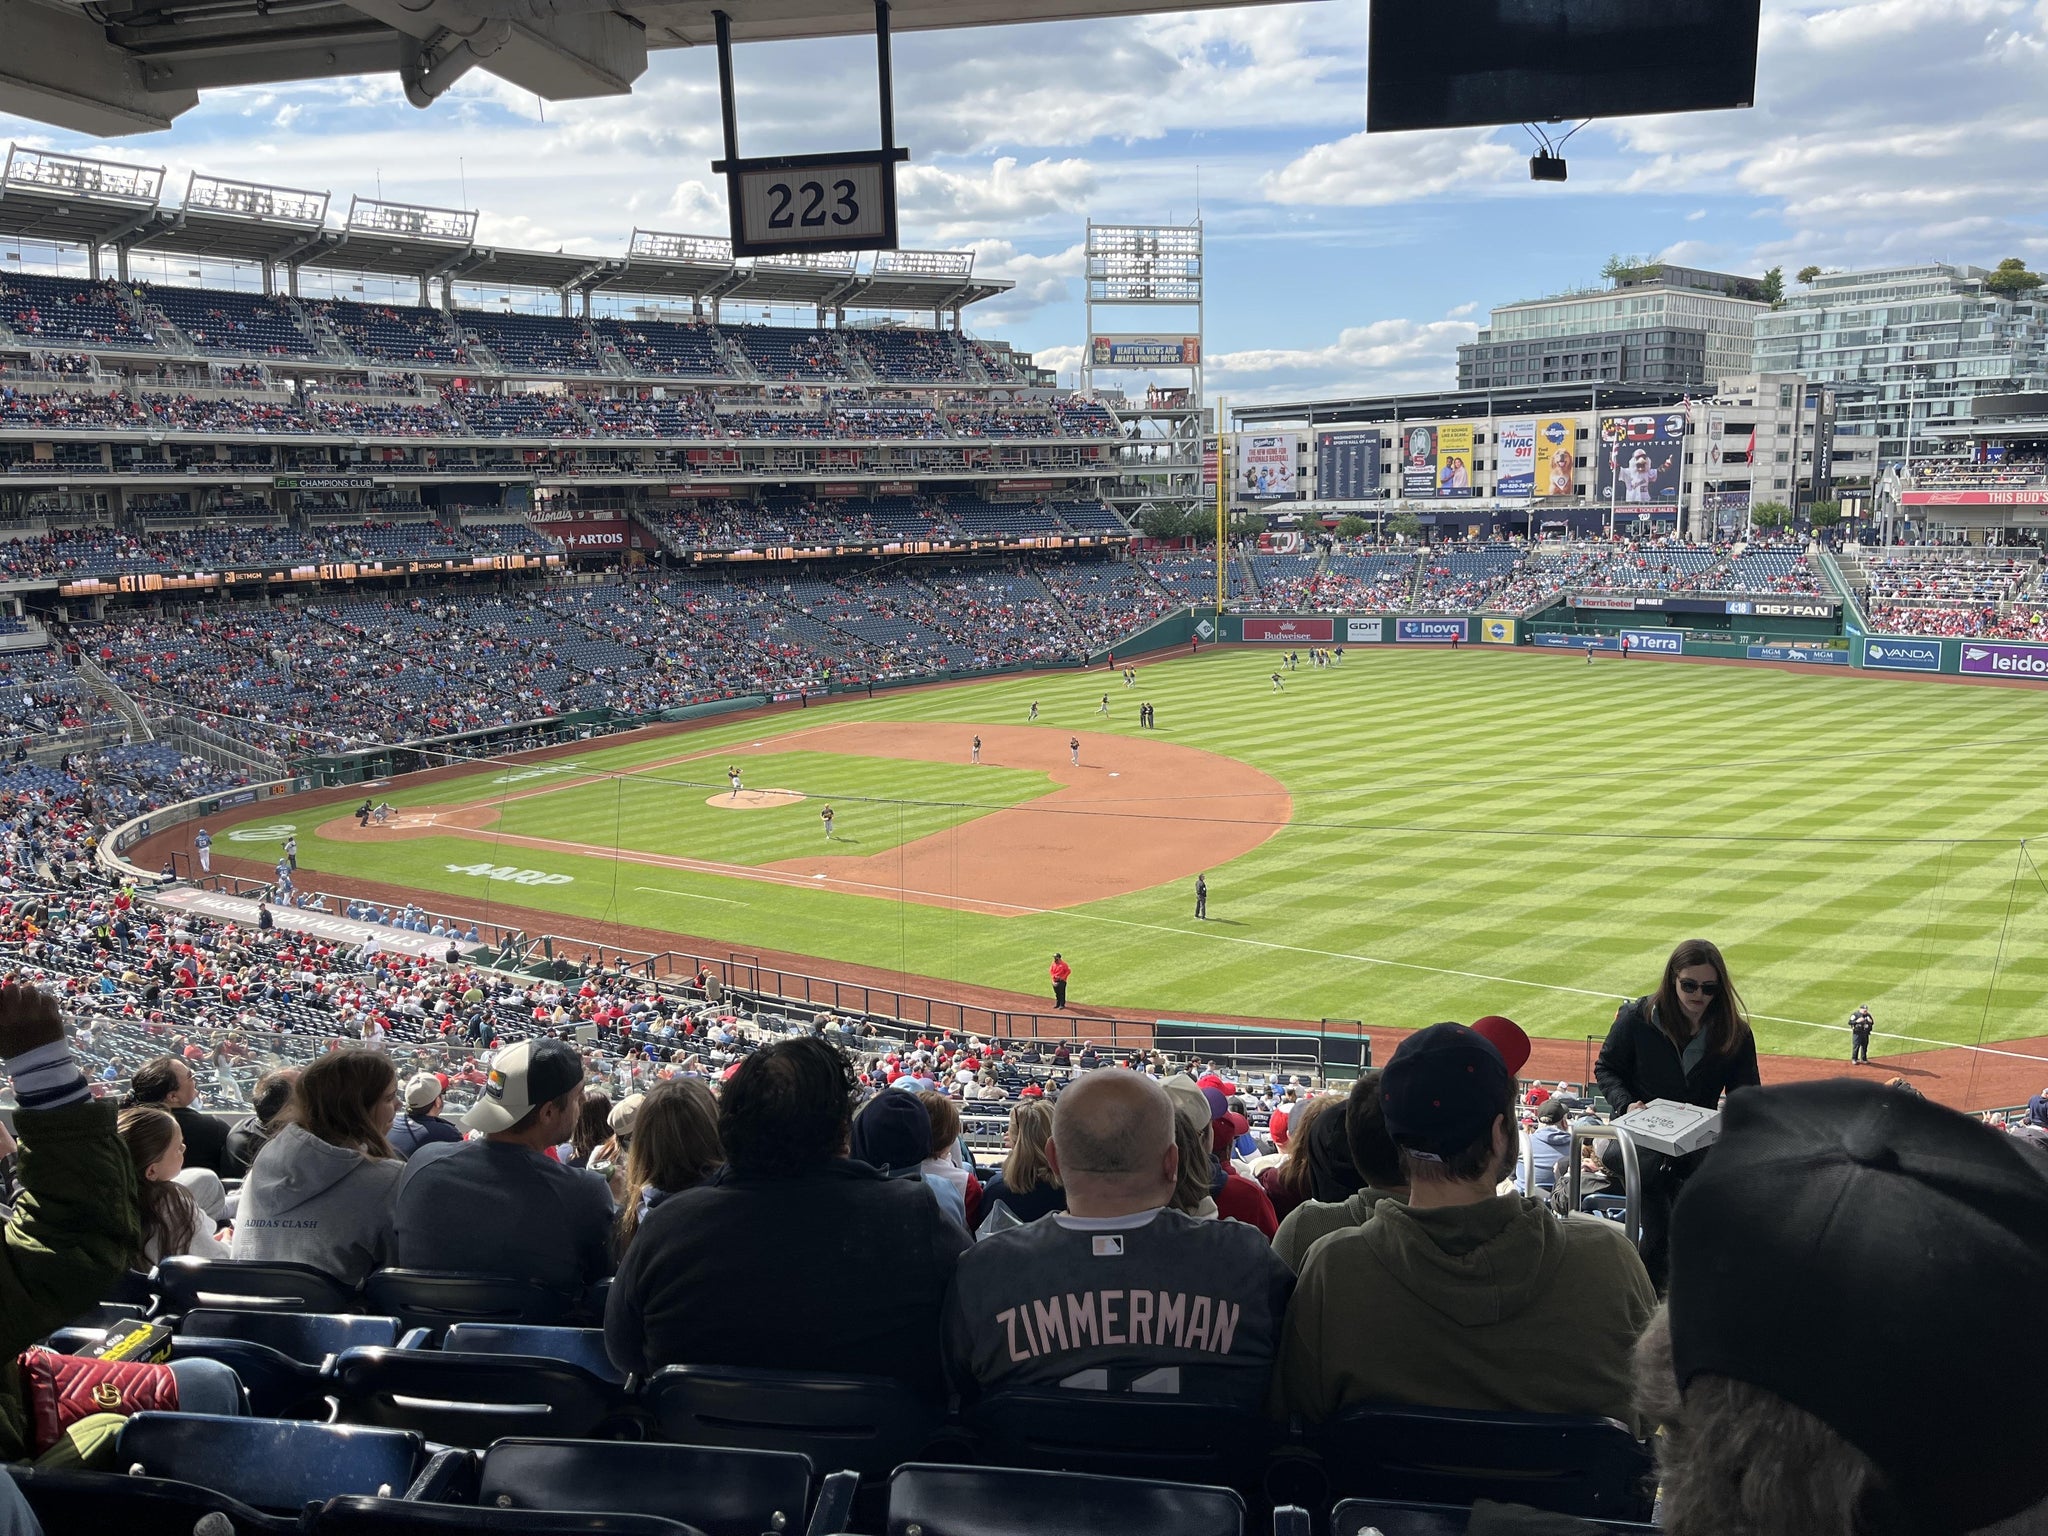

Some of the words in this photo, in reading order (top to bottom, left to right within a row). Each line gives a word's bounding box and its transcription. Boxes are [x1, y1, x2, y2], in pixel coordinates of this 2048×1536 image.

[767, 179, 859, 229] 223
[1116, 346, 1145, 355] BEAUTIFUL
[1146, 346, 1165, 355] VIEWS
[1165, 346, 1177, 354] AND
[1113, 355, 1134, 363] AWARD
[1135, 354, 1160, 363] WINNING
[1160, 354, 1180, 362] BREWS
[1504, 438, 1533, 448] HVAC
[1515, 447, 1532, 457] 911
[1269, 454, 1288, 462] BASEBALL
[299, 479, 349, 487] CHAMPIONS
[350, 479, 372, 487] CLUB
[1988, 492, 2013, 503] THIS
[2015, 492, 2048, 503] BUD'S
[521, 510, 573, 522] Nationals
[579, 533, 623, 545] ARTOIS
[418, 562, 442, 570] BETMGM
[235, 571, 262, 580] BETMGM
[1582, 598, 1607, 607] Harris
[1607, 599, 1633, 608] Teeter
[1729, 602, 1747, 613] 4:18
[1793, 605, 1829, 616] FAN
[1420, 622, 1460, 634] Inova
[1264, 631, 1311, 640] Budweiser
[1640, 636, 1677, 650] Terra
[1813, 651, 1833, 659] MGM
[1884, 648, 1935, 659] VANDA
[445, 863, 575, 886] AARP
[312, 918, 427, 949] NATIONALS
[244, 1219, 279, 1229] ADIDAS
[282, 1220, 318, 1229] CLASH
[995, 1289, 1240, 1362] ZIMMERMAN
